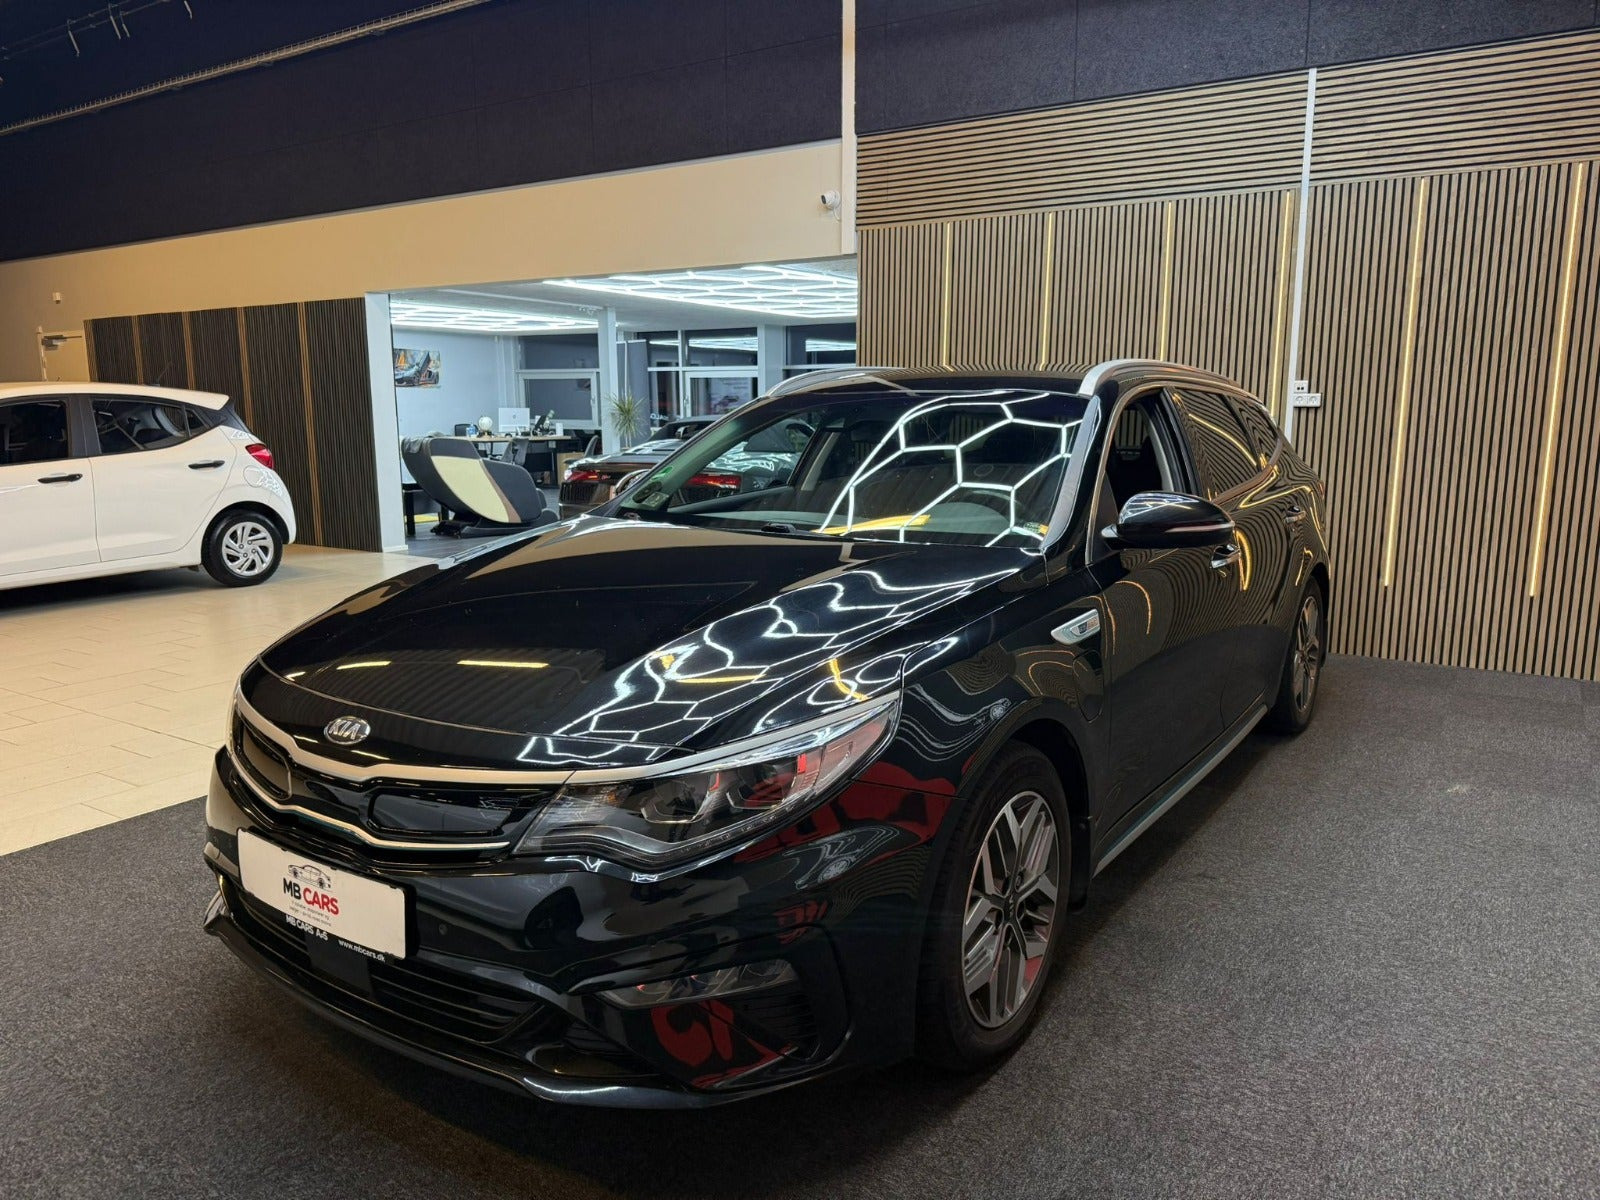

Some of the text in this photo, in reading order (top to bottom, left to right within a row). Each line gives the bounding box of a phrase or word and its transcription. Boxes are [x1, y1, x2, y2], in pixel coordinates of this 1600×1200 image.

[328, 719, 361, 740] KIA
[283, 876, 301, 900] MB
[303, 887, 340, 916] CARS
[285, 914, 296, 927] MB
[296, 920, 314, 935] CARS
[338, 939, 386, 963] www.mbcars.dk
